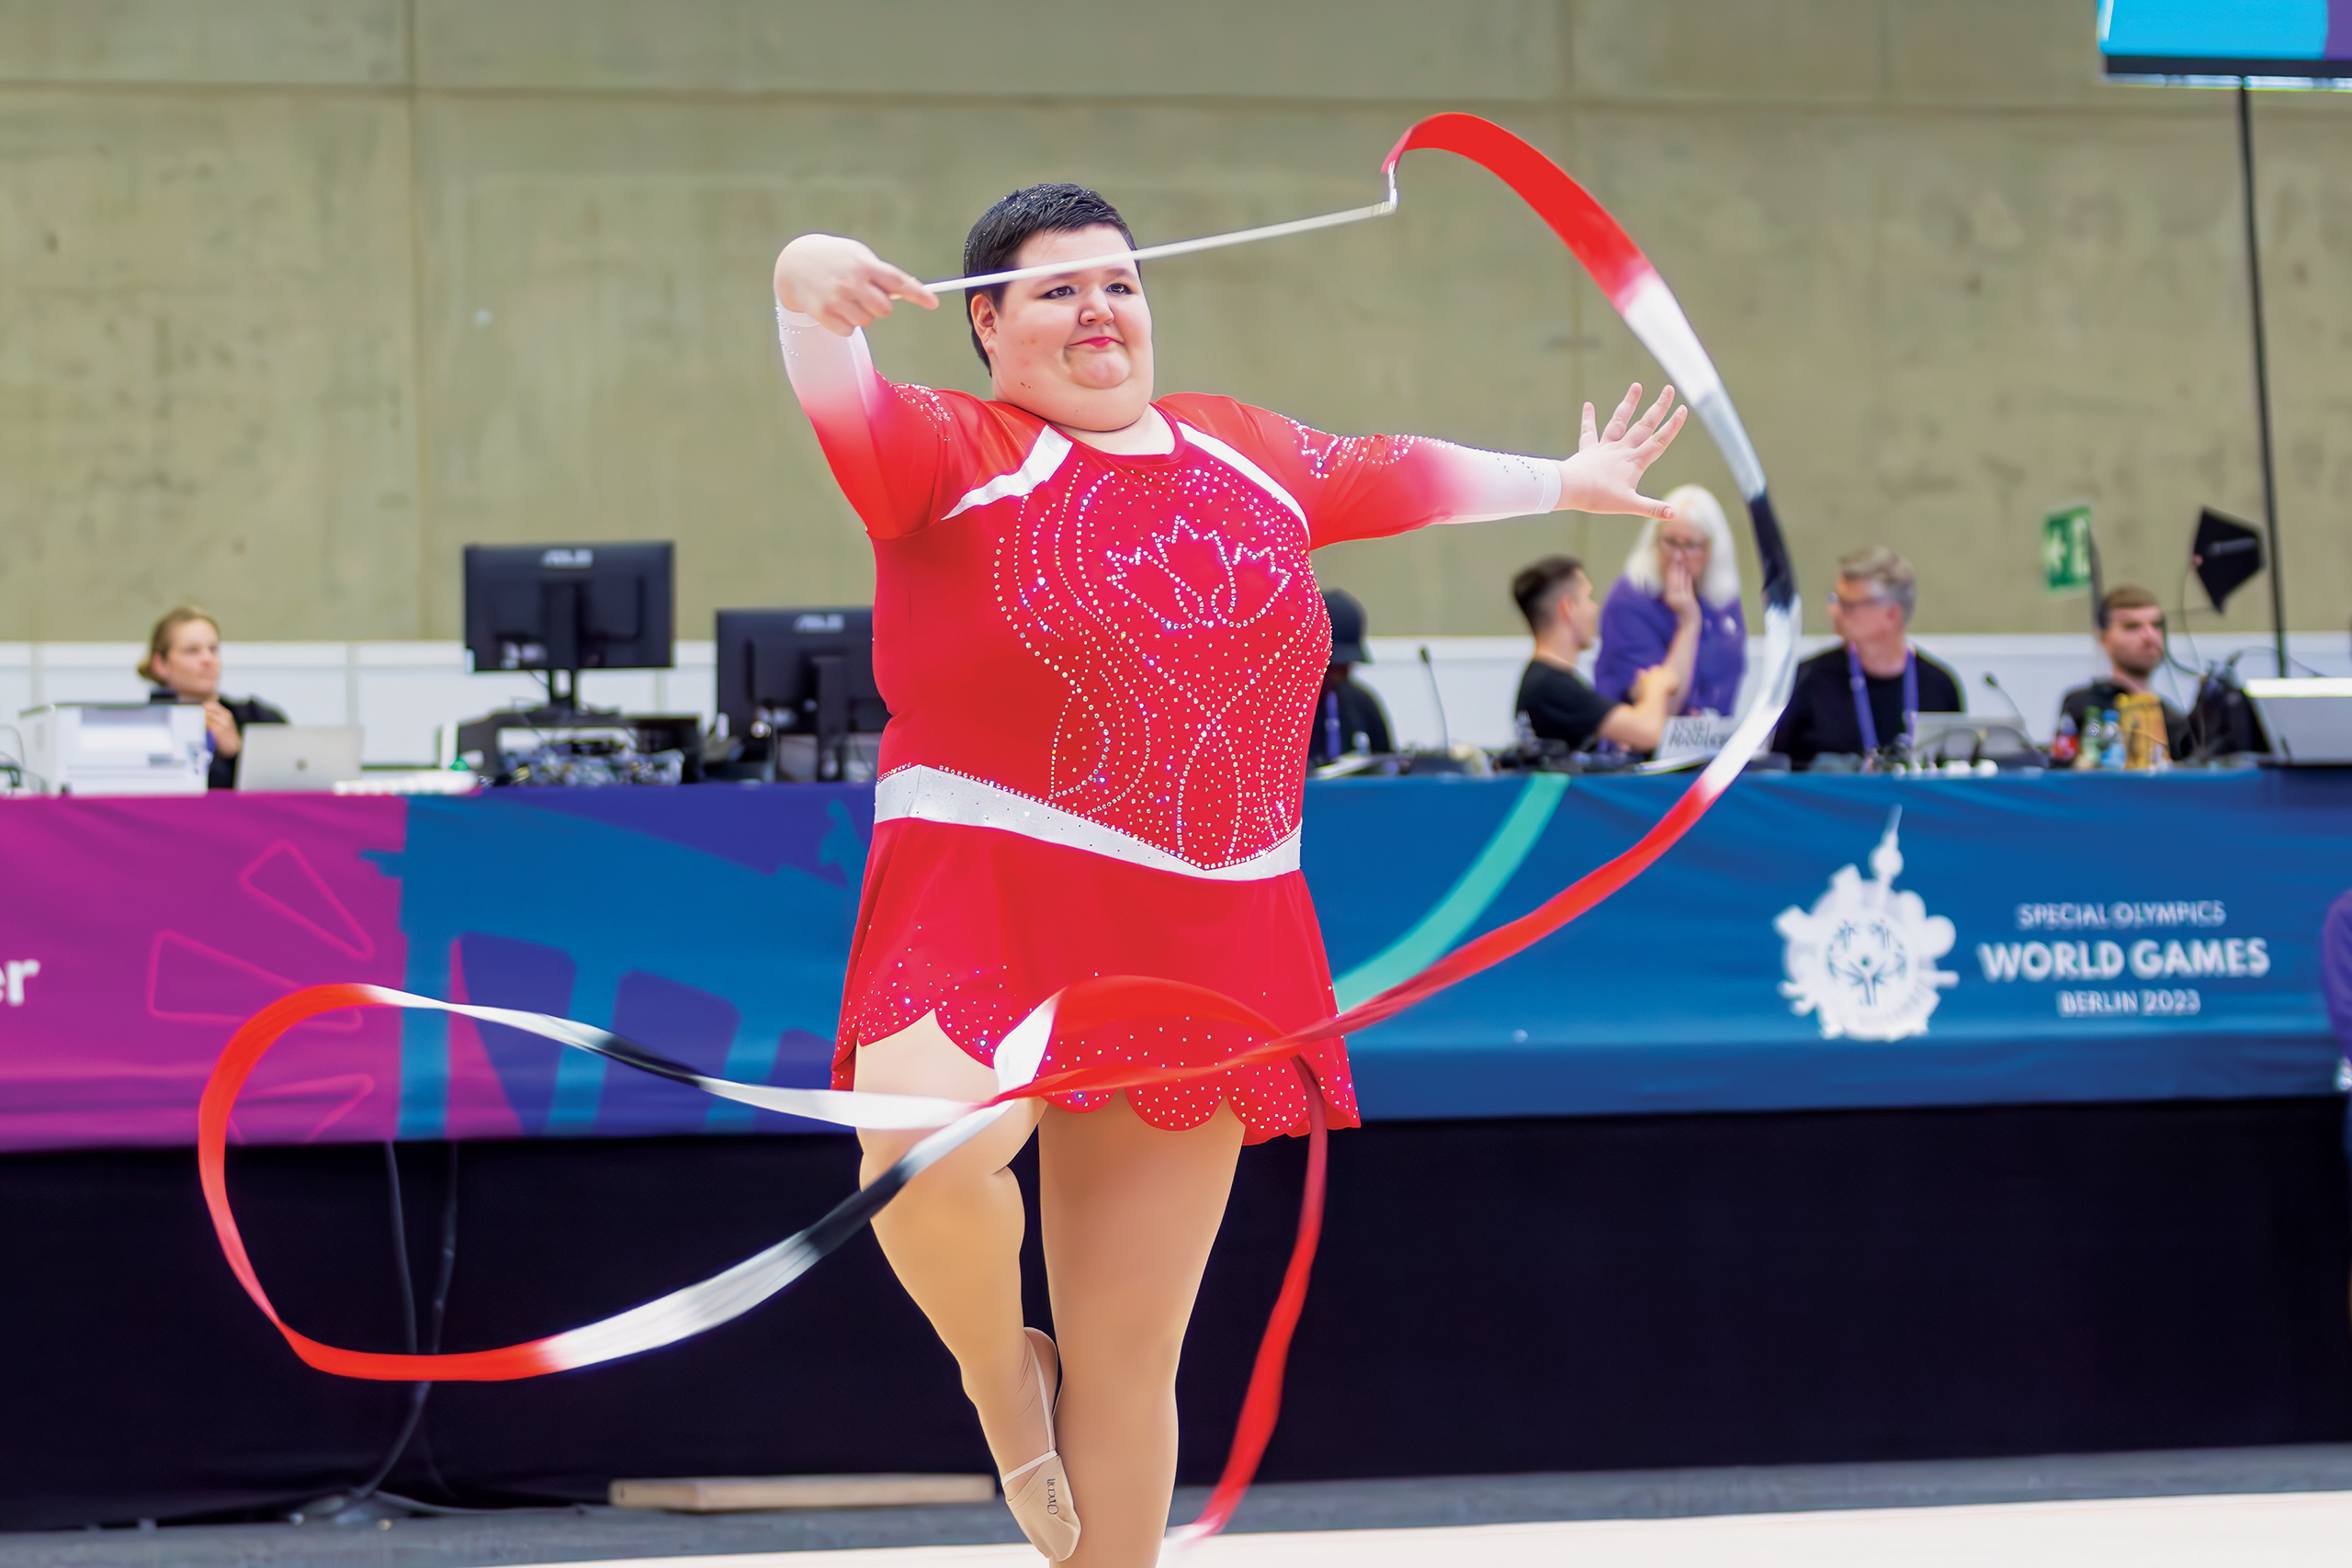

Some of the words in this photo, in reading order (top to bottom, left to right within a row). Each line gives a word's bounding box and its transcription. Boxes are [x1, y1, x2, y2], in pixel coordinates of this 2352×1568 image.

[2016, 902, 2108, 931] SPECIAL
[2110, 900, 2227, 929] OLYMPICS
[1978, 940, 2125, 982] WORLD
[2128, 937, 2271, 979] GAMES
[0, 958, 41, 1007] r
[2056, 990, 2139, 1018] BERLIN
[2139, 988, 2201, 1016] 2023
